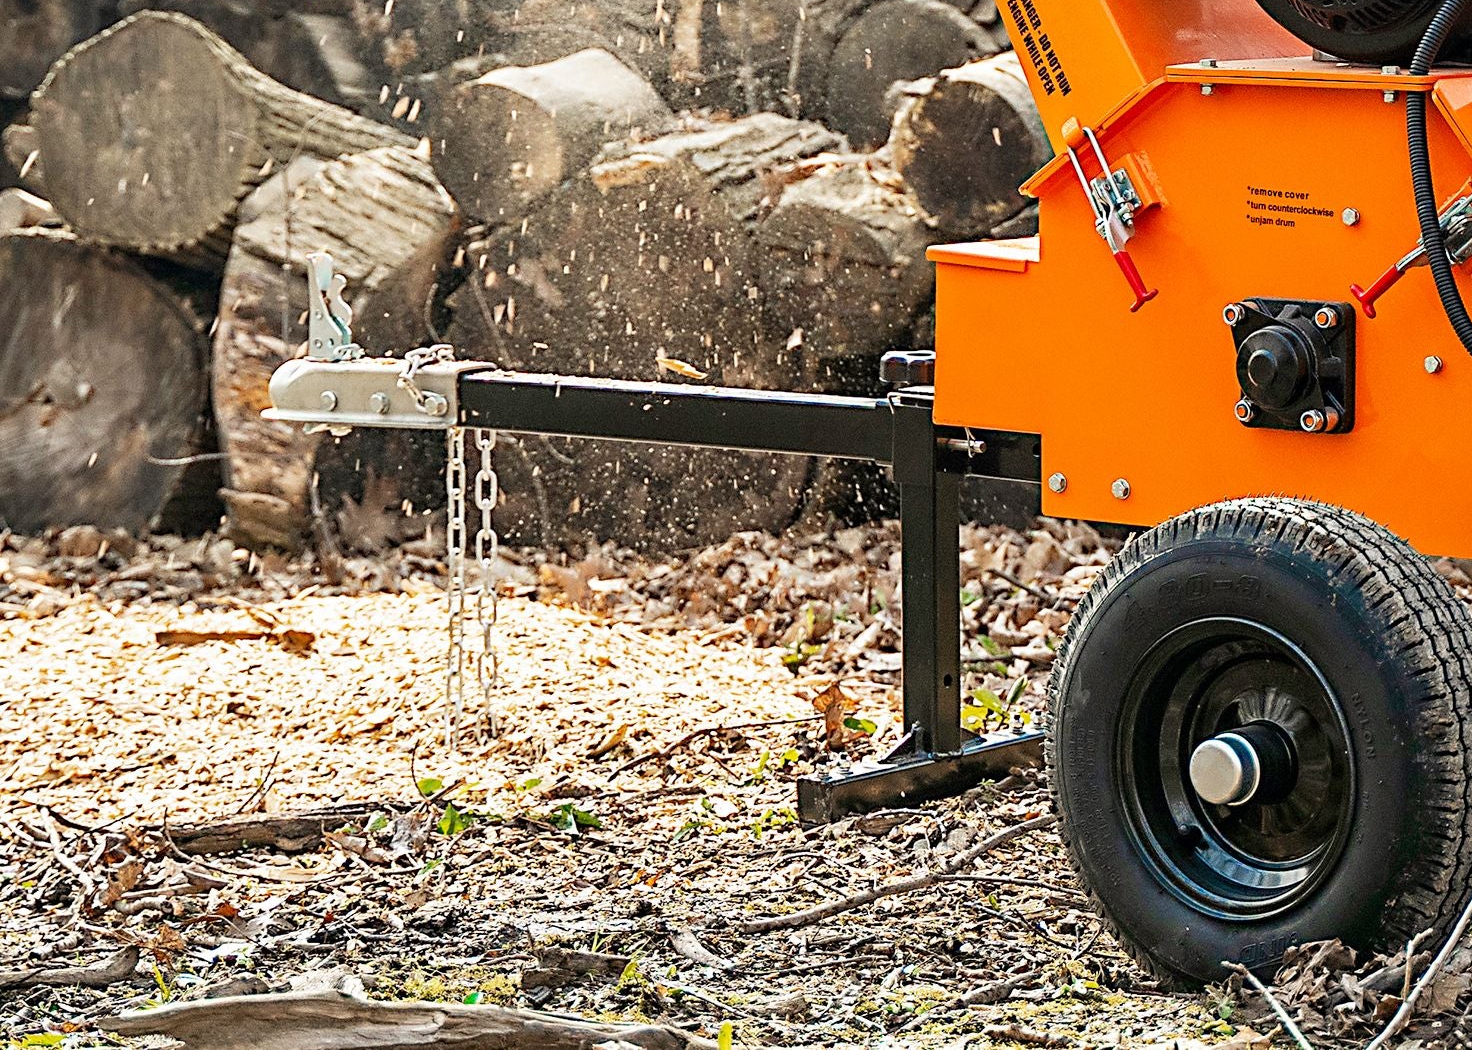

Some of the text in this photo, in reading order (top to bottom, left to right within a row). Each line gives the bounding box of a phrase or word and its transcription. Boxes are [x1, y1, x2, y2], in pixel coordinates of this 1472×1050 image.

[1023, 32, 1043, 69] WHILE
[1037, 66, 1056, 96] OPEN
[1038, 33, 1051, 52] DO
[1045, 49, 1062, 73] NOT
[1055, 70, 1072, 97] RUN
[1284, 190, 1310, 200] cover
[1268, 203, 1334, 217] counterclockwise
[1275, 217, 1296, 228] drum
